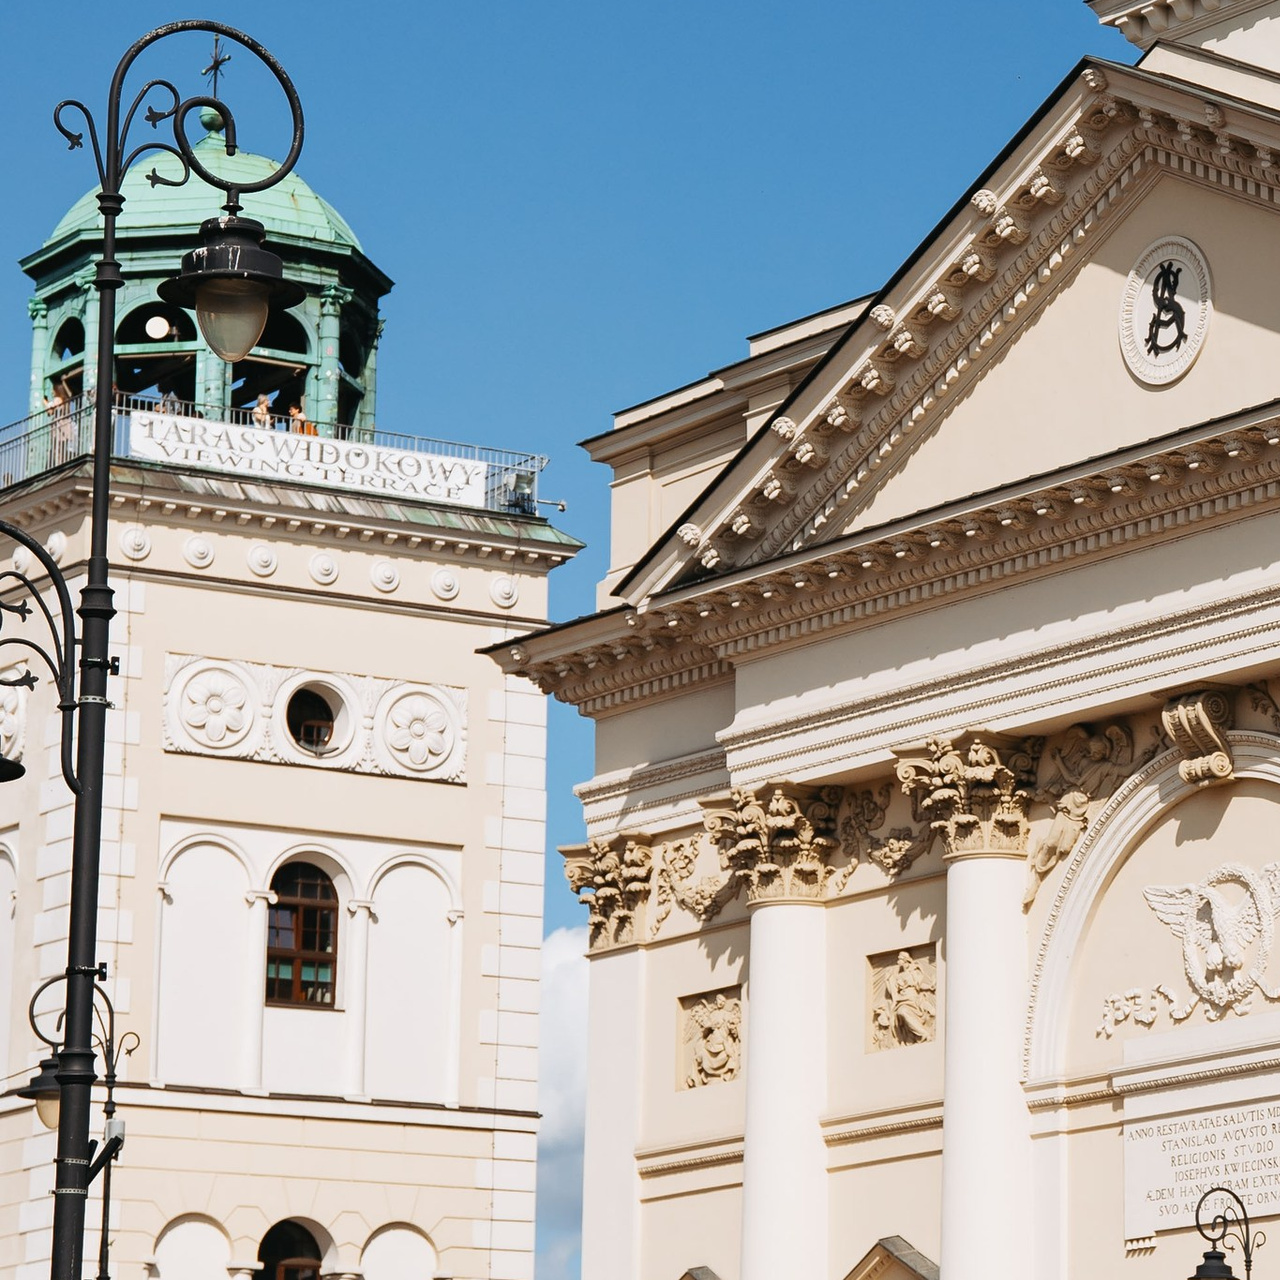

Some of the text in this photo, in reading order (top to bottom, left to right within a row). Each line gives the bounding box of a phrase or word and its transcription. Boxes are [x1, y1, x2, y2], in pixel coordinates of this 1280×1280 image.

[139, 416, 481, 486] TARAS WIDOKOWY
[156, 441, 463, 500] VIEWING TERRACE
[1127, 1127, 1154, 1141] ANNO
[1156, 1116, 1221, 1136] RESTAVRATAE
[1223, 1109, 1265, 1126] SALVTIS
[1161, 1133, 1217, 1152] STANISLAO
[1223, 1125, 1268, 1142] AVGVSTO
[1171, 1140, 1274, 1167] RELIGIONIS STVDIO
[1158, 1204, 1179, 1216] SVO
[1182, 1200, 1210, 1214] AEE
